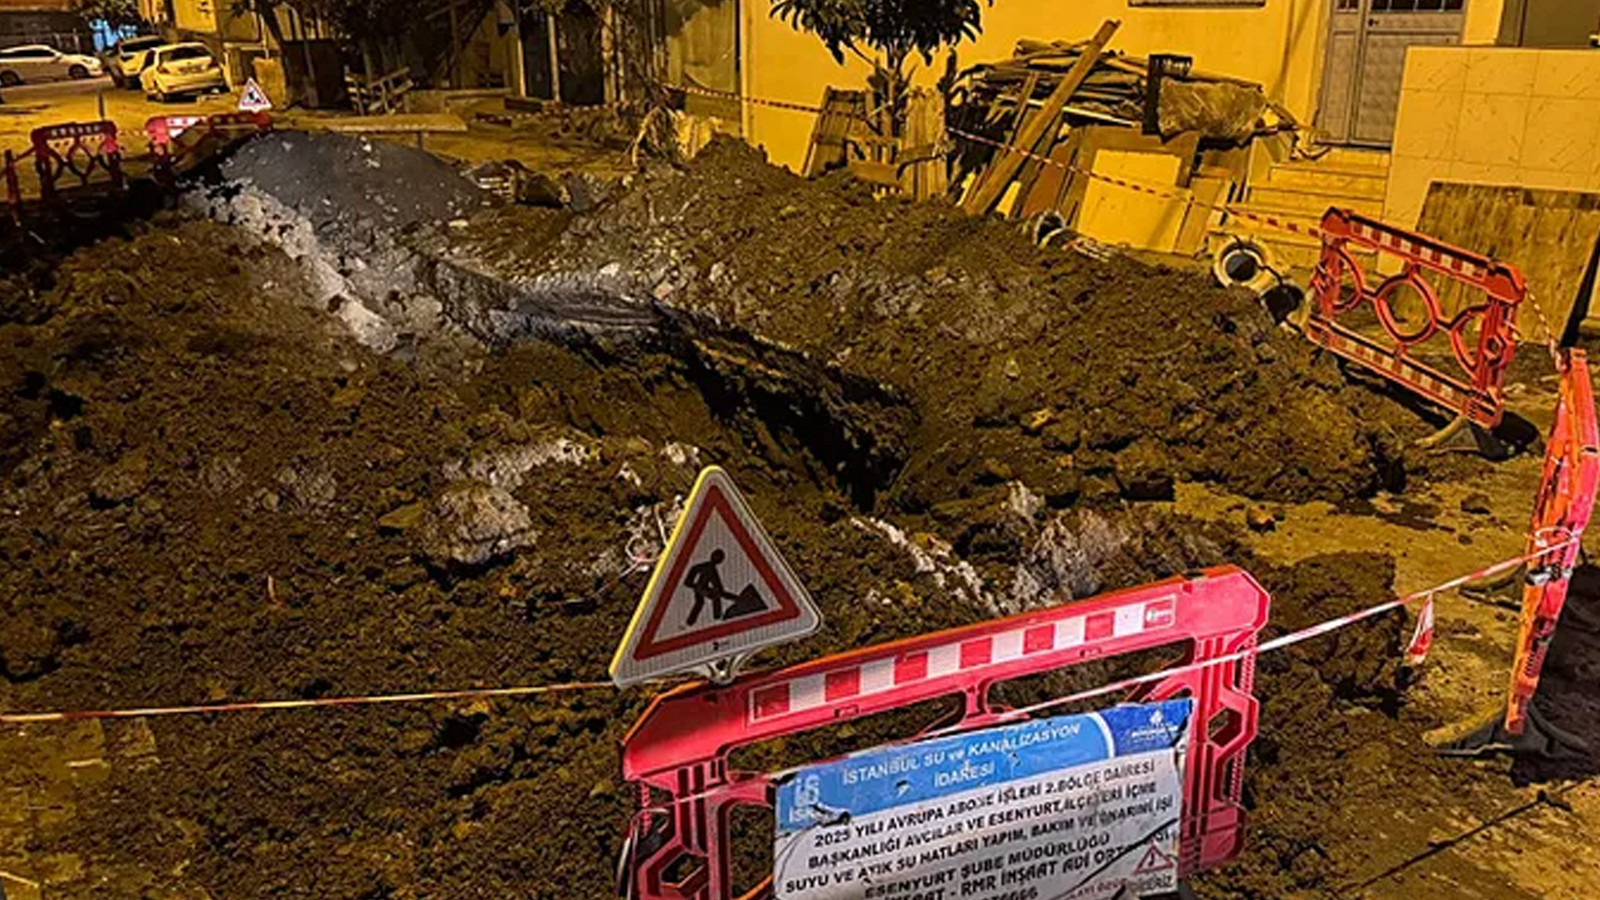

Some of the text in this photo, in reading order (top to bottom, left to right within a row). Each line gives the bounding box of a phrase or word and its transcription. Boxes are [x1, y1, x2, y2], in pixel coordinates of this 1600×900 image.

[842, 723, 1081, 785] İSTANBUL SU ve KANALİZASYON
[934, 761, 996, 788] İDARESİ
[808, 837, 901, 869] BAŞKANLIĞI
[905, 822, 963, 848] AVCILAR
[967, 815, 986, 830] VE
[1126, 781, 1157, 799] İÇME
[814, 828, 851, 848] 2025
[855, 820, 884, 838] YILI
[887, 807, 944, 831] AVRUPA
[998, 783, 1041, 804] İŞLERİ
[1103, 759, 1155, 782] DAİRESİ
[785, 875, 830, 894] SUYU
[833, 868, 854, 883] VE
[896, 855, 917, 871] SU
[920, 838, 978, 864] HATLARI
[982, 828, 1028, 847] YAPIM,
[1030, 818, 1075, 837] BAKIM
[1078, 815, 1094, 827] VE
[865, 868, 956, 898] ESENYURT
[961, 855, 1004, 879] ŞUBE
[1008, 831, 1110, 865] MÜDÜRLÜĞÜ
[961, 875, 996, 897] RMR
[1001, 860, 1058, 885] İNŞAAT
[1062, 851, 1090, 873] ADİ
